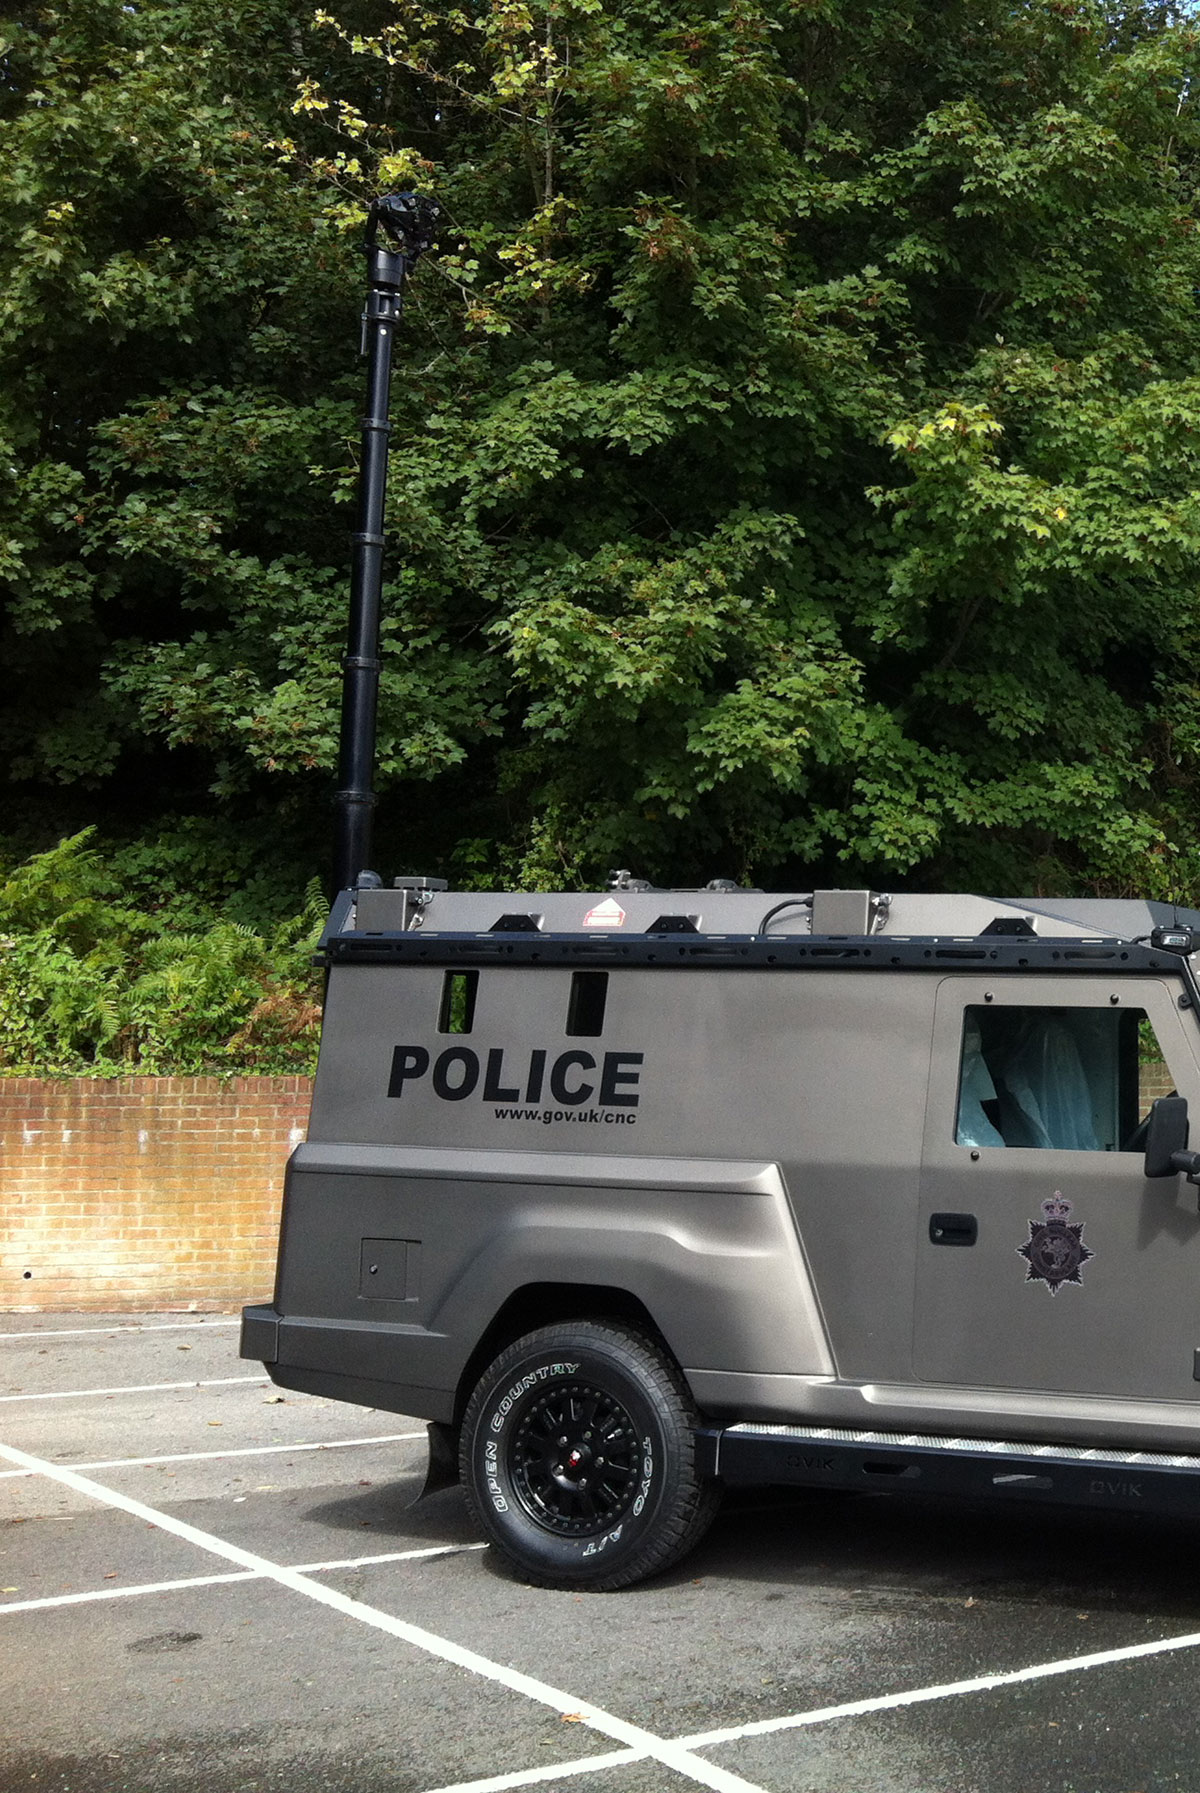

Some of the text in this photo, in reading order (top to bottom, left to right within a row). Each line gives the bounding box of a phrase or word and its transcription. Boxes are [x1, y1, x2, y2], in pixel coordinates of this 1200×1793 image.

[387, 1045, 644, 1107] POLICE
[494, 1108, 636, 1125] www.gov.uk/cnc
[485, 1362, 581, 1512] OPEN COUNTRY
[633, 1436, 653, 1516] TOYO
